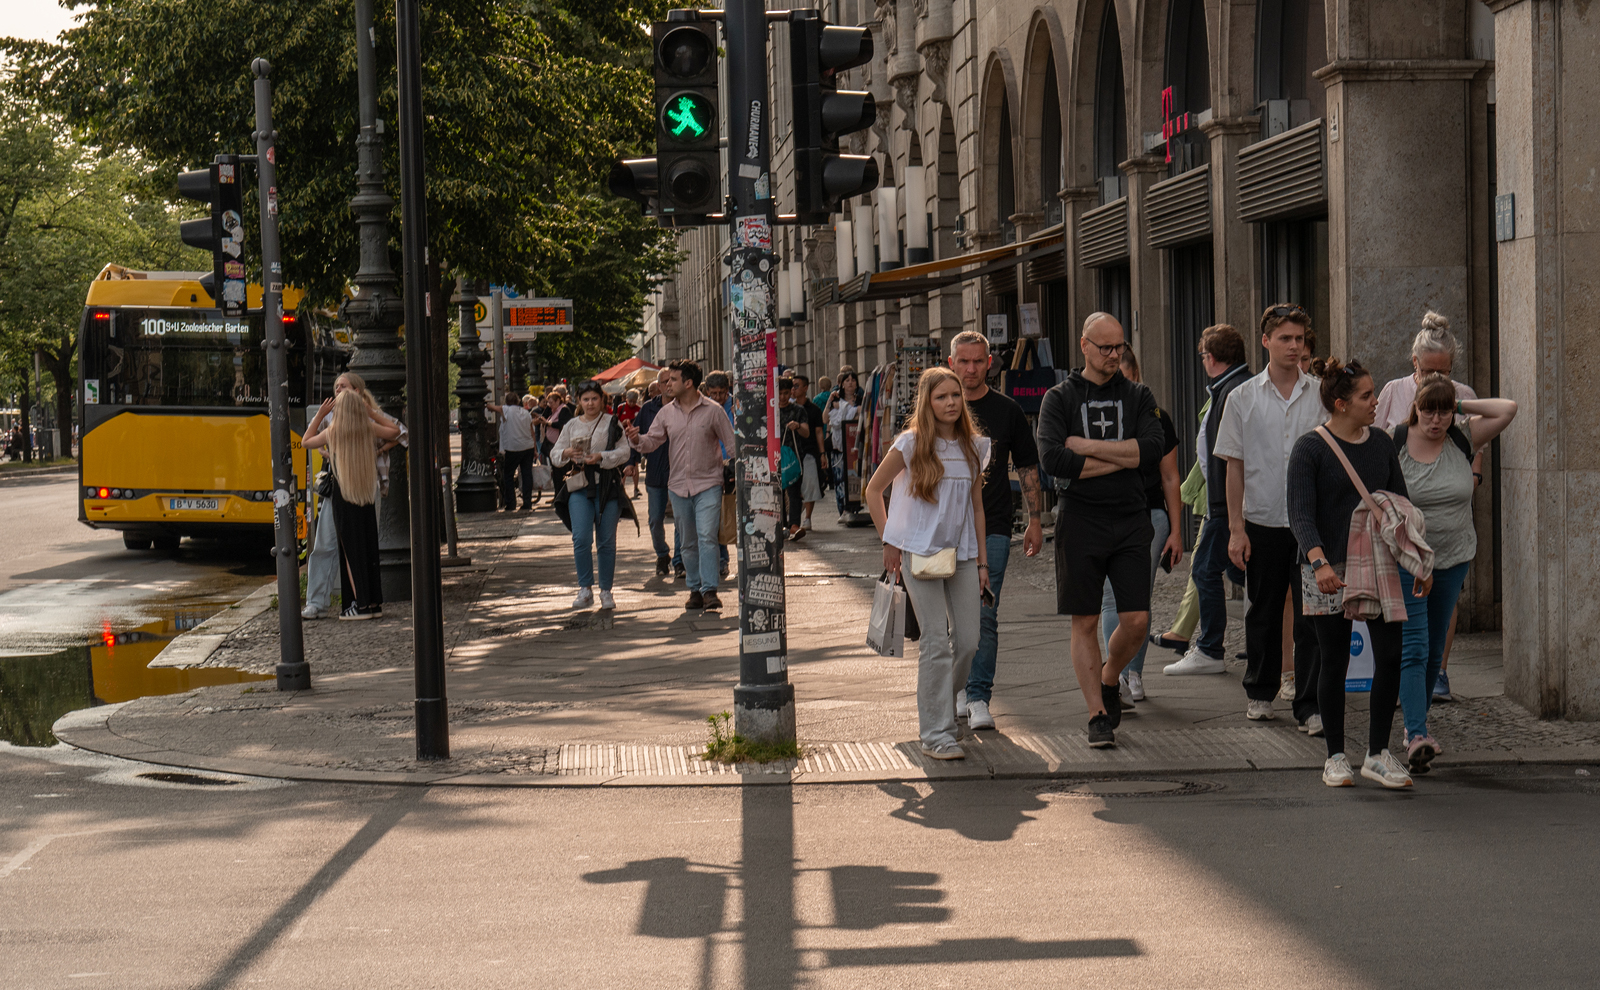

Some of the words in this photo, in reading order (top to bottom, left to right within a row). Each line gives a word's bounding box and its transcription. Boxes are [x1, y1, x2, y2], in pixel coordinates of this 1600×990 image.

[748, 100, 761, 147] CHURMANE
[141, 319, 166, 336] 100
[166, 322, 180, 332] S+U
[180, 322, 224, 334] Zoologischer
[225, 322, 249, 333] Garten
[1013, 387, 1047, 396] BERLIN
[177, 500, 182, 509] B
[187, 500, 192, 508] V
[196, 500, 216, 509] 5630
[755, 573, 783, 586] KOOL
[750, 580, 783, 594] SAVAS
[745, 636, 778, 647] NESSUNO
